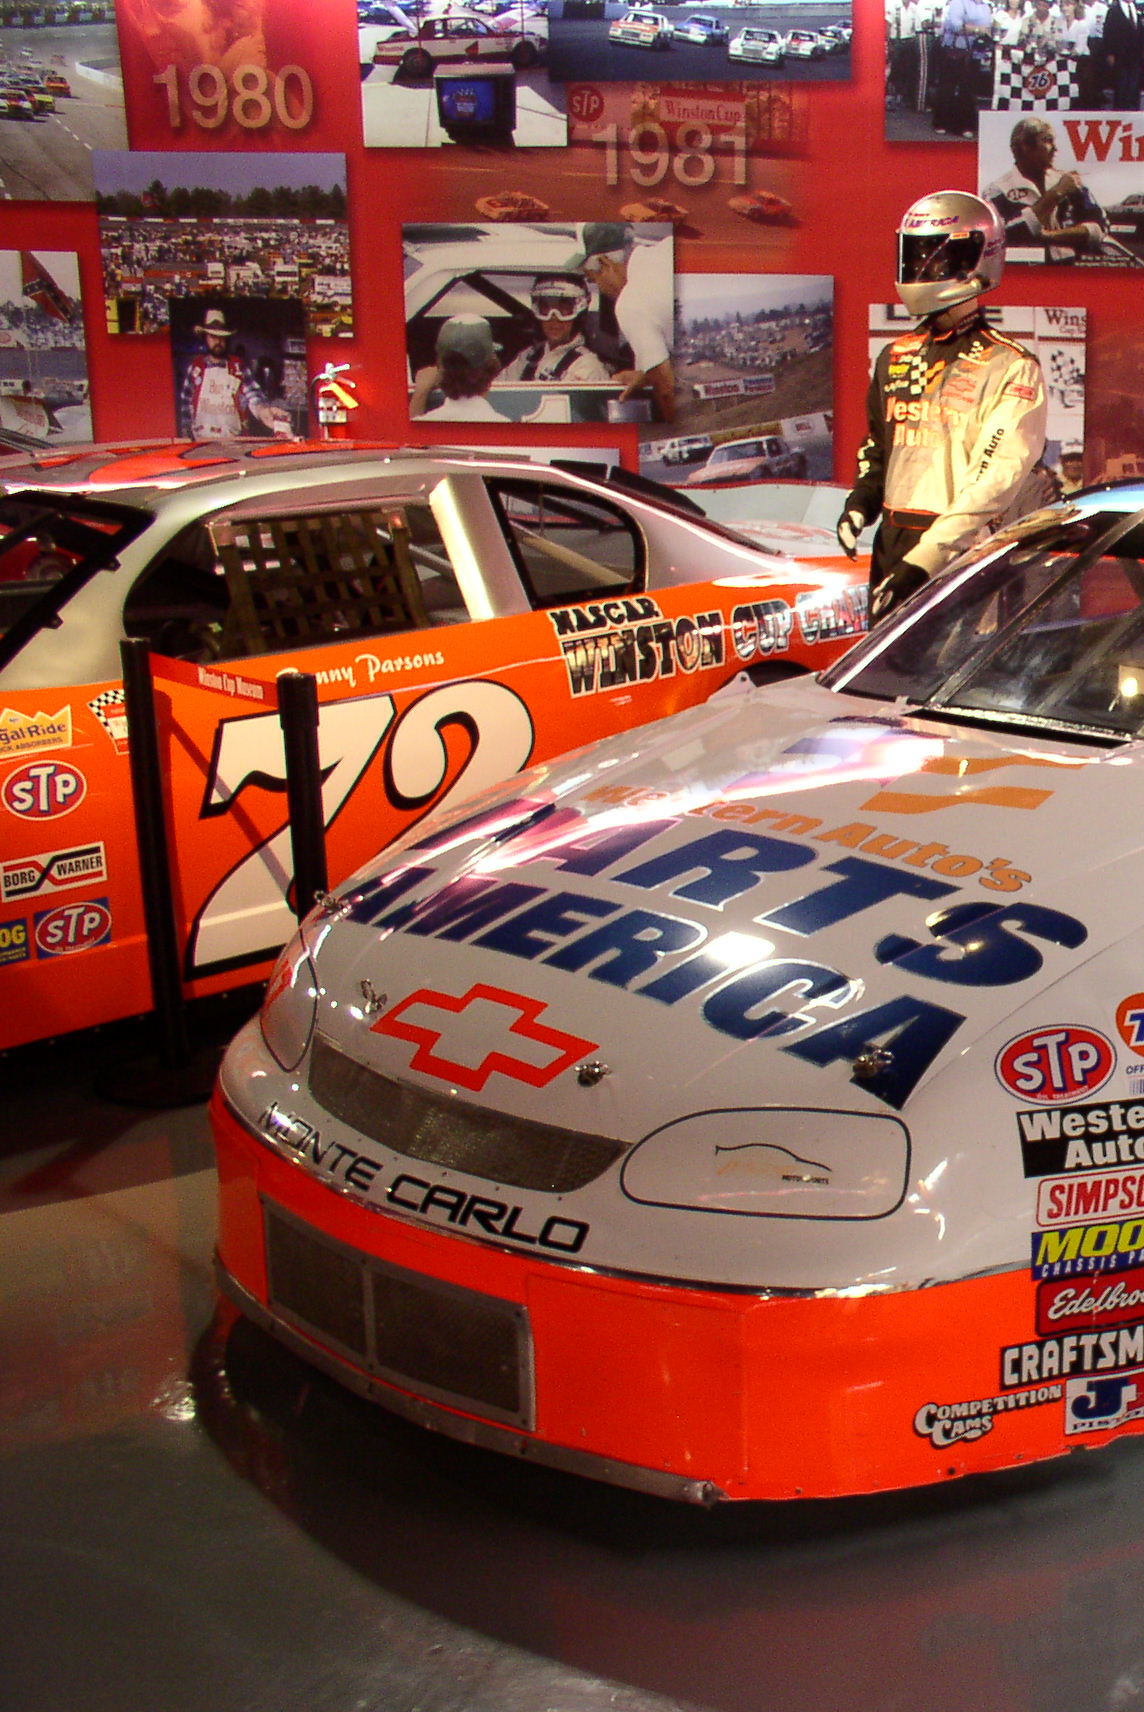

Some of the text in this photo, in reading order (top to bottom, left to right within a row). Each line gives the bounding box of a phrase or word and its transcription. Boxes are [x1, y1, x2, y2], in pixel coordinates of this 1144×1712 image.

[152, 64, 313, 129] 1980
[1029, 73, 1048, 88] 76
[572, 88, 600, 115] STP
[666, 103, 740, 122] Winston Cup
[592, 122, 746, 186] 1981
[1044, 307, 1086, 327] Wins
[983, 428, 1005, 458] Auto
[549, 597, 661, 636] NASCAR
[562, 612, 725, 697] WINSTON
[730, 599, 795, 661] CUP
[355, 650, 444, 682] Parsons
[0, 723, 66, 745] gal Ride
[12, 766, 77, 811] STP
[583, 784, 1032, 893] Wetern Auto's
[3, 855, 102, 888] BORG WARNER
[0, 925, 26, 948] OG
[46, 907, 100, 943] STP
[340, 865, 967, 1112] AMERICA
[1013, 1031, 1099, 1093] STP
[258, 1101, 590, 1253] MONTE CARLO
[1041, 1256, 1117, 1279] CHASSIS
[915, 1384, 1063, 1435] COMPETITION
[932, 1412, 994, 1447] CAMS
